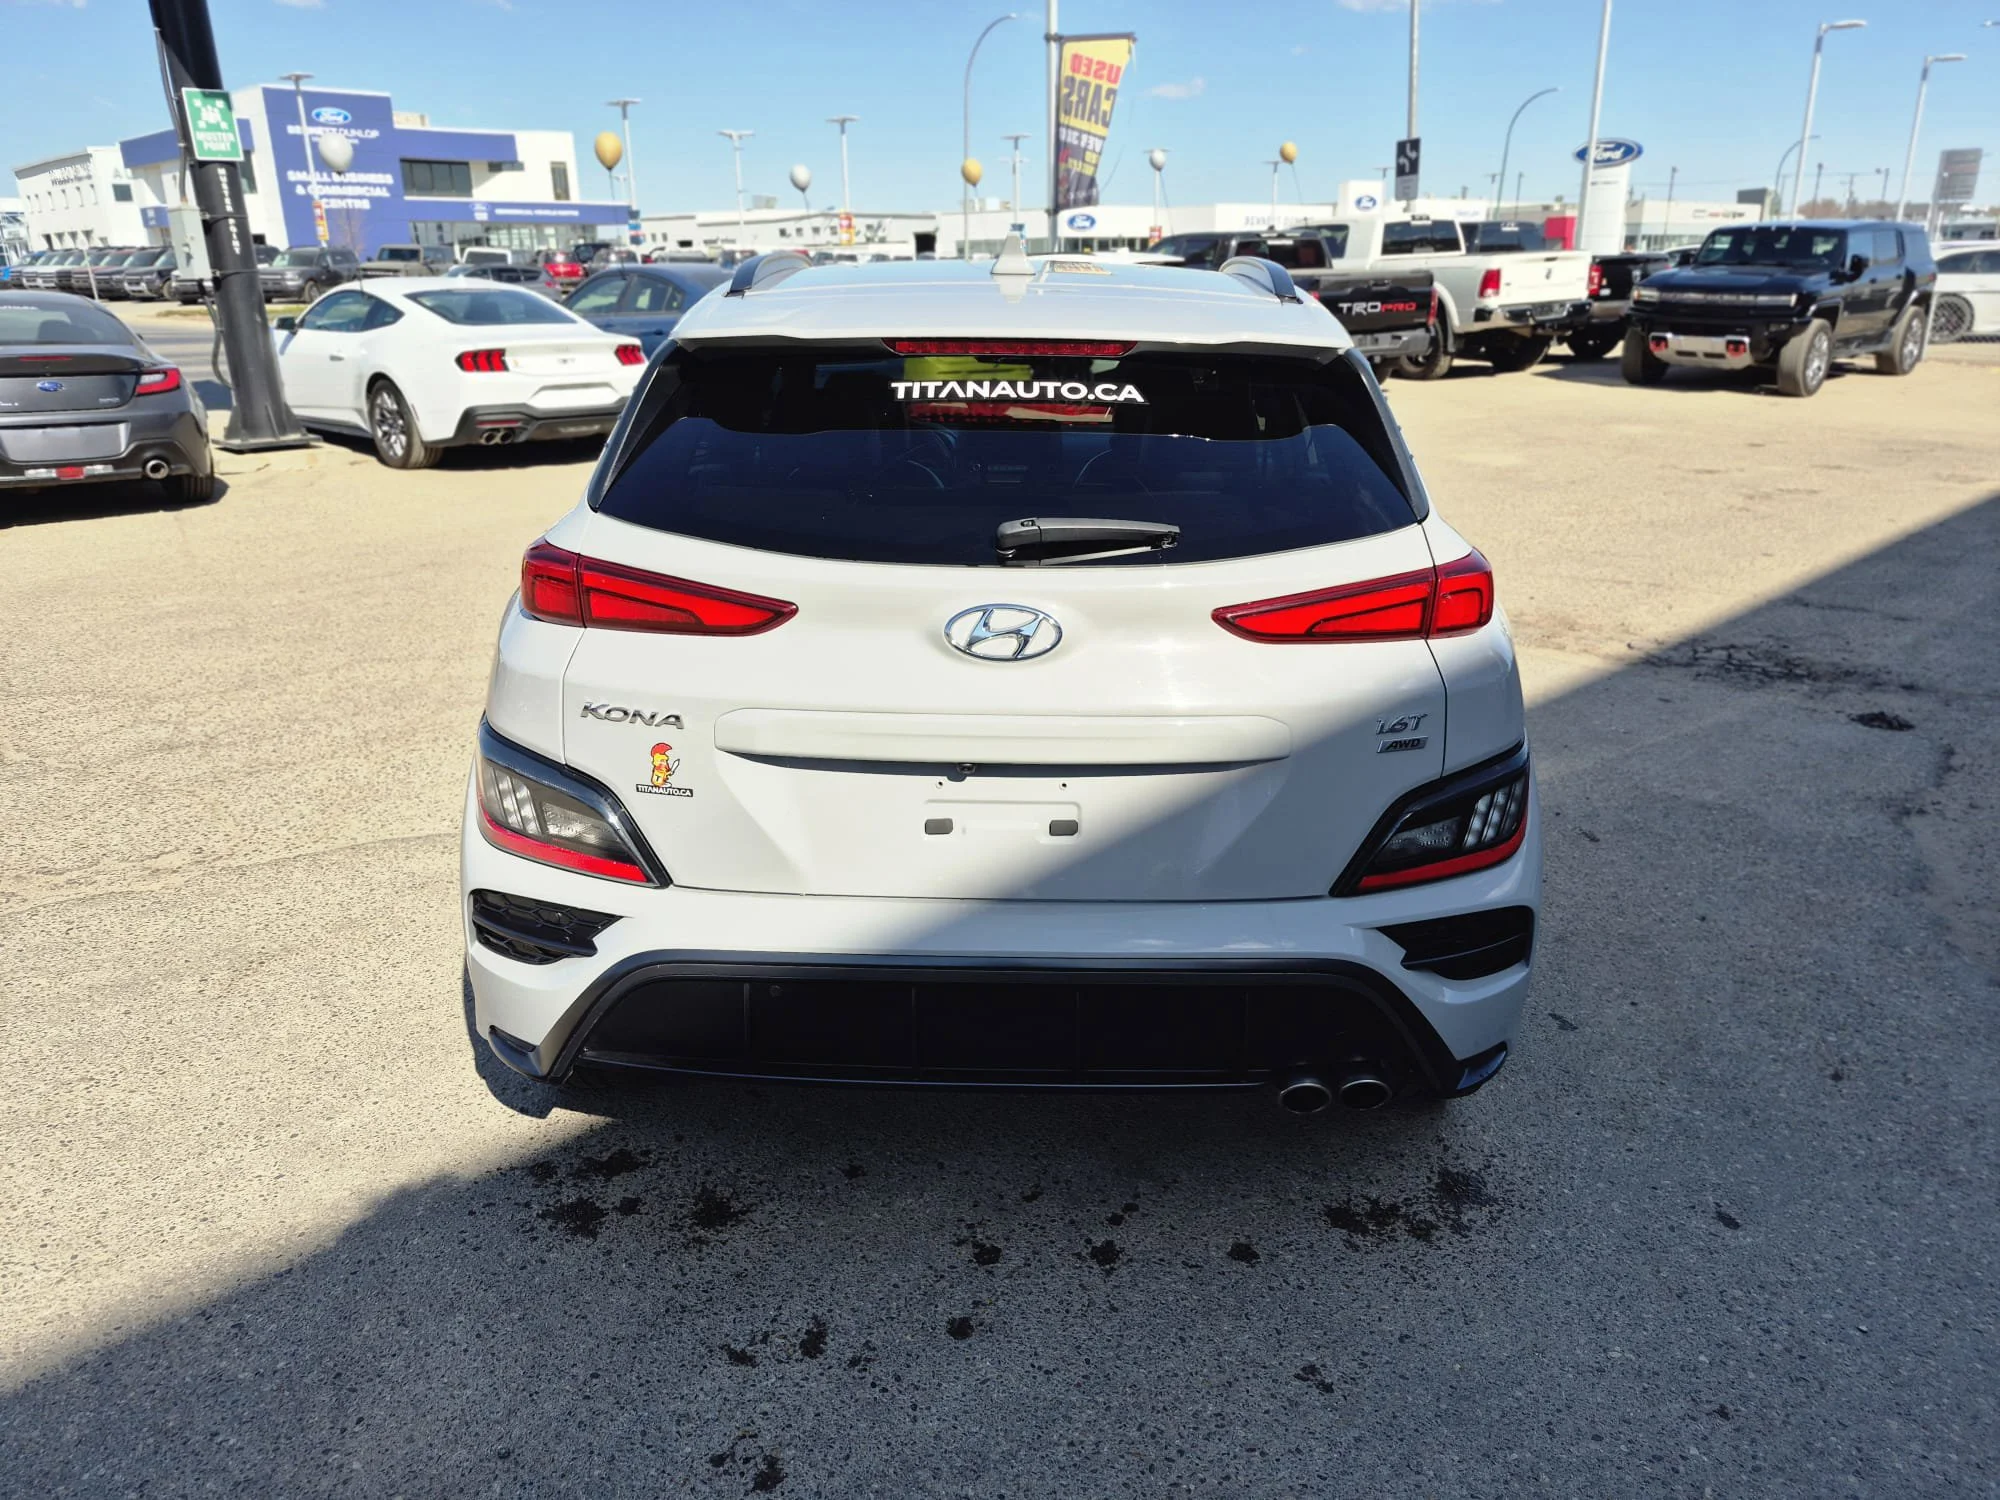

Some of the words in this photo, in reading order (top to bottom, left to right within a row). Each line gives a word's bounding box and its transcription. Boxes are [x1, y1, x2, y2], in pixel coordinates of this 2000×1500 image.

[890, 380, 1145, 403] TITANAUTO.CA
[580, 702, 684, 730] KONA
[1384, 738, 1420, 751] AWD
[637, 785, 692, 796] TITANAUTO.CA
